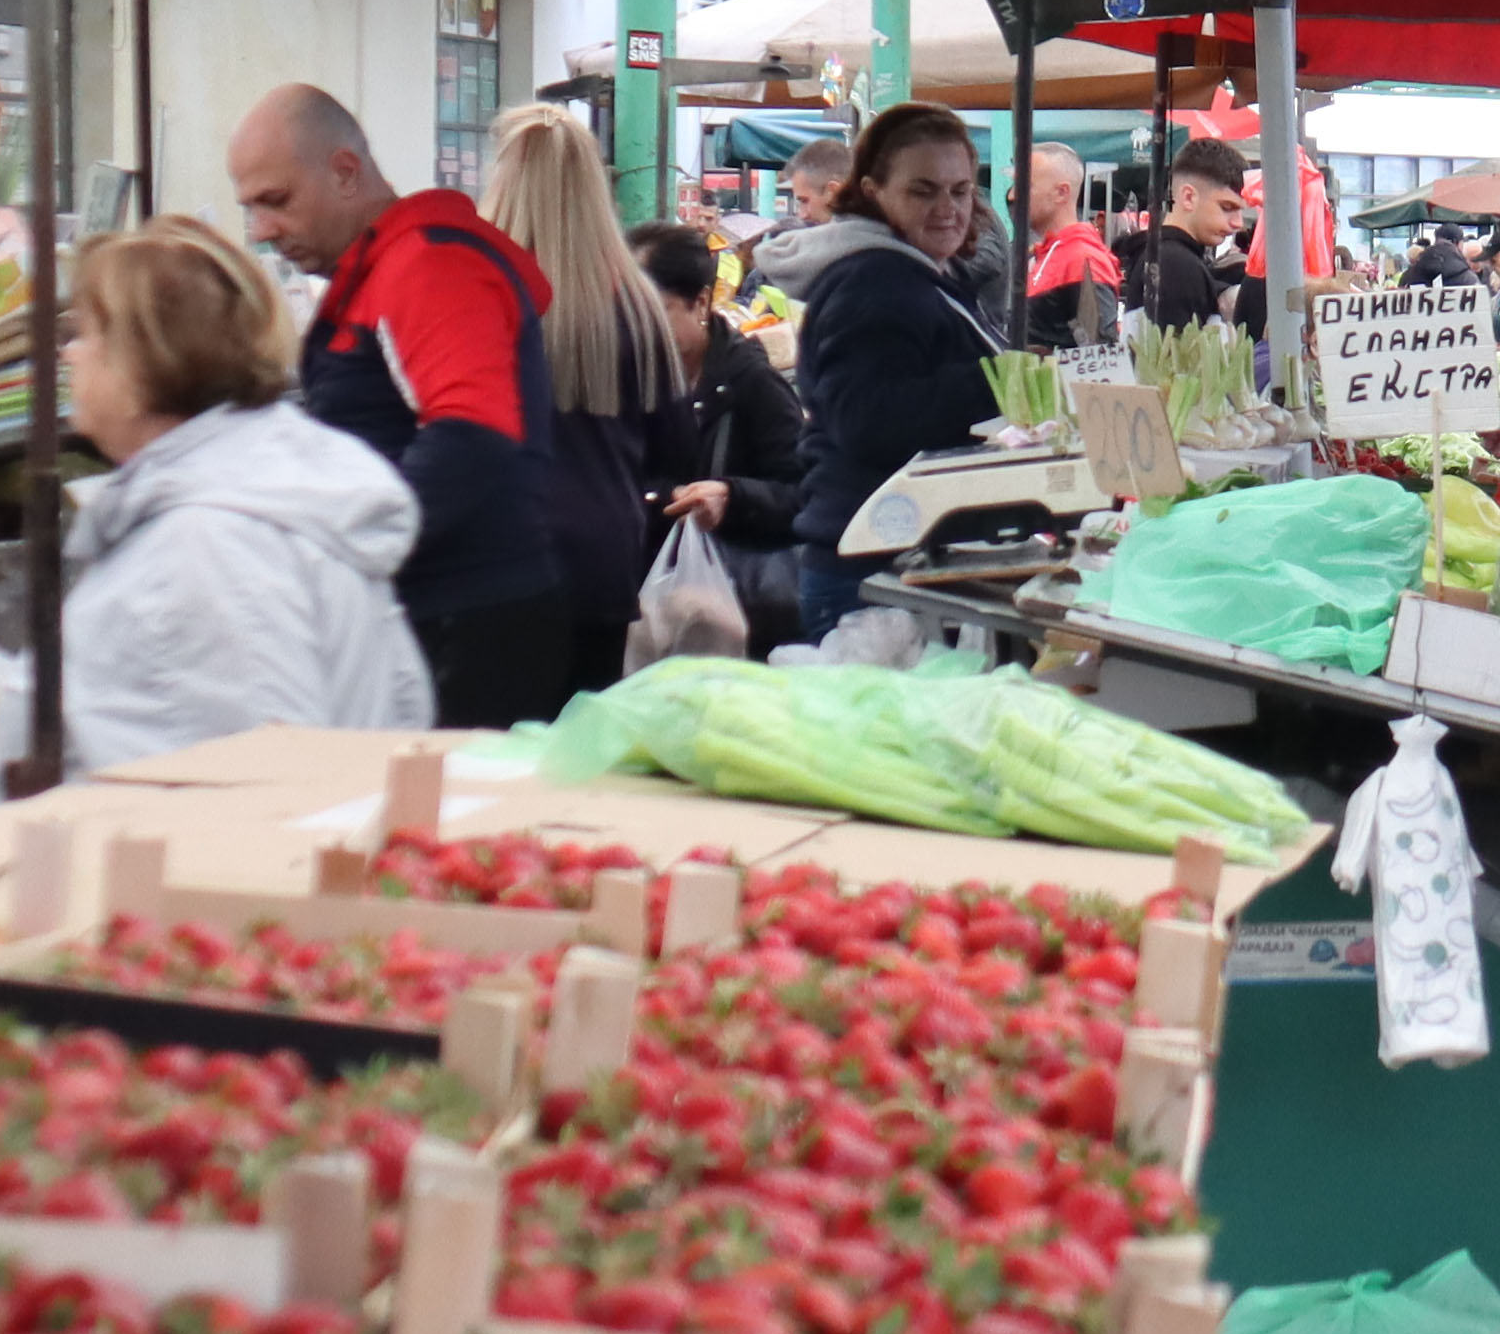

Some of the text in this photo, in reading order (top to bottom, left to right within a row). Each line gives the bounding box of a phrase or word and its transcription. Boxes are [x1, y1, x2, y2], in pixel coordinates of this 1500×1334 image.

[629, 36, 661, 50] FCK
[628, 48, 661, 63] SNS
[1346, 358, 1493, 404] ЕКСТРА
